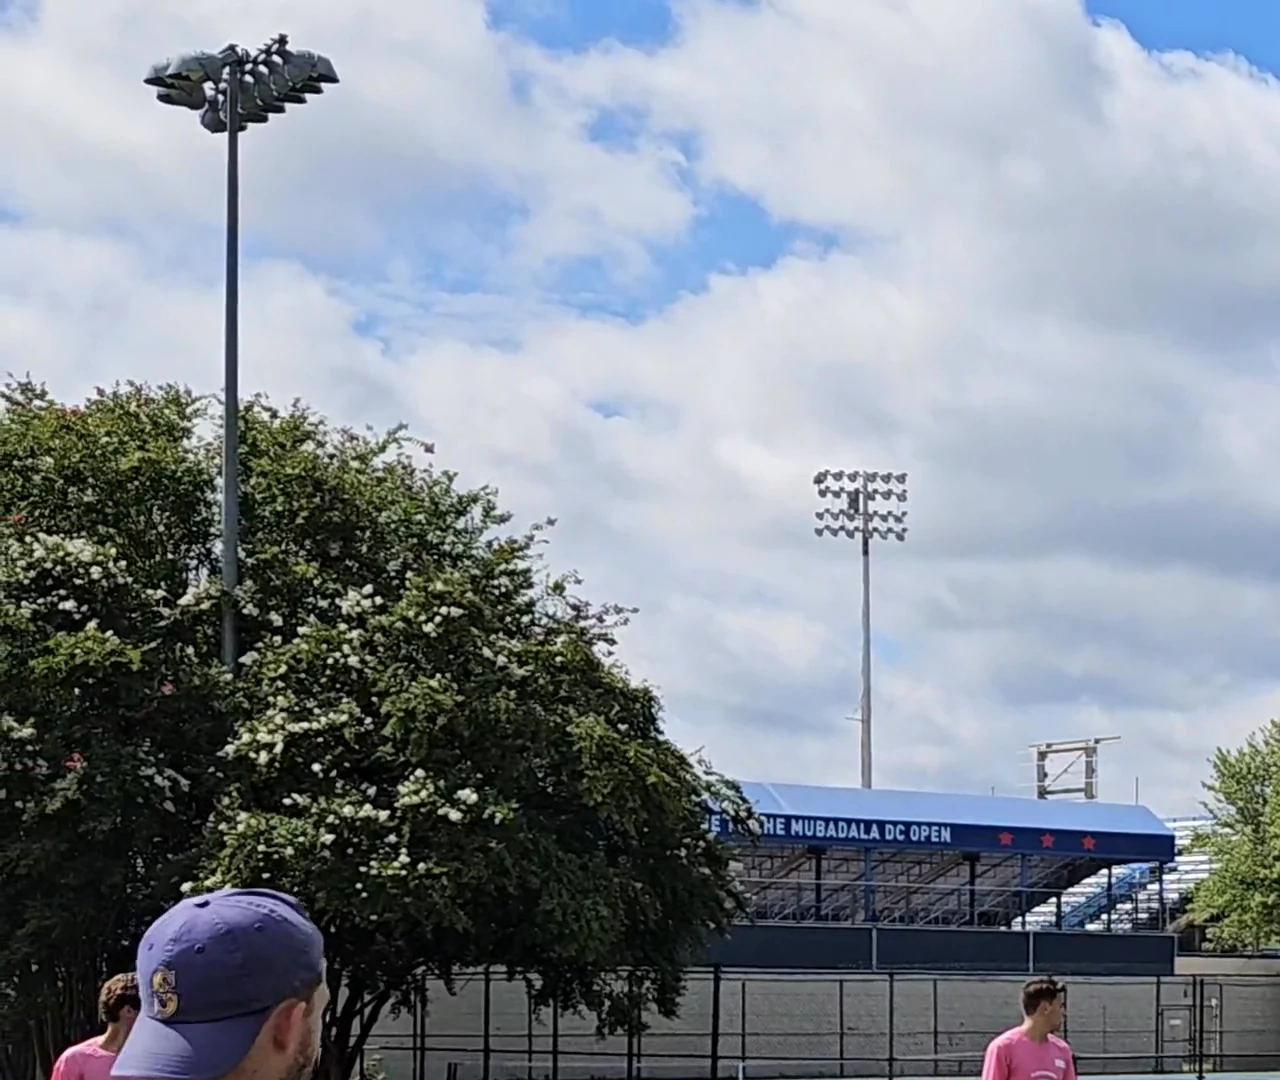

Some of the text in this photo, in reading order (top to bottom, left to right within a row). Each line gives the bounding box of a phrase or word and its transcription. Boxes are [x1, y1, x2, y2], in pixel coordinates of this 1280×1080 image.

[756, 815, 786, 835] HE
[791, 818, 880, 840] MUBADALA
[885, 824, 906, 841] DC
[910, 825, 952, 843] OPEN
